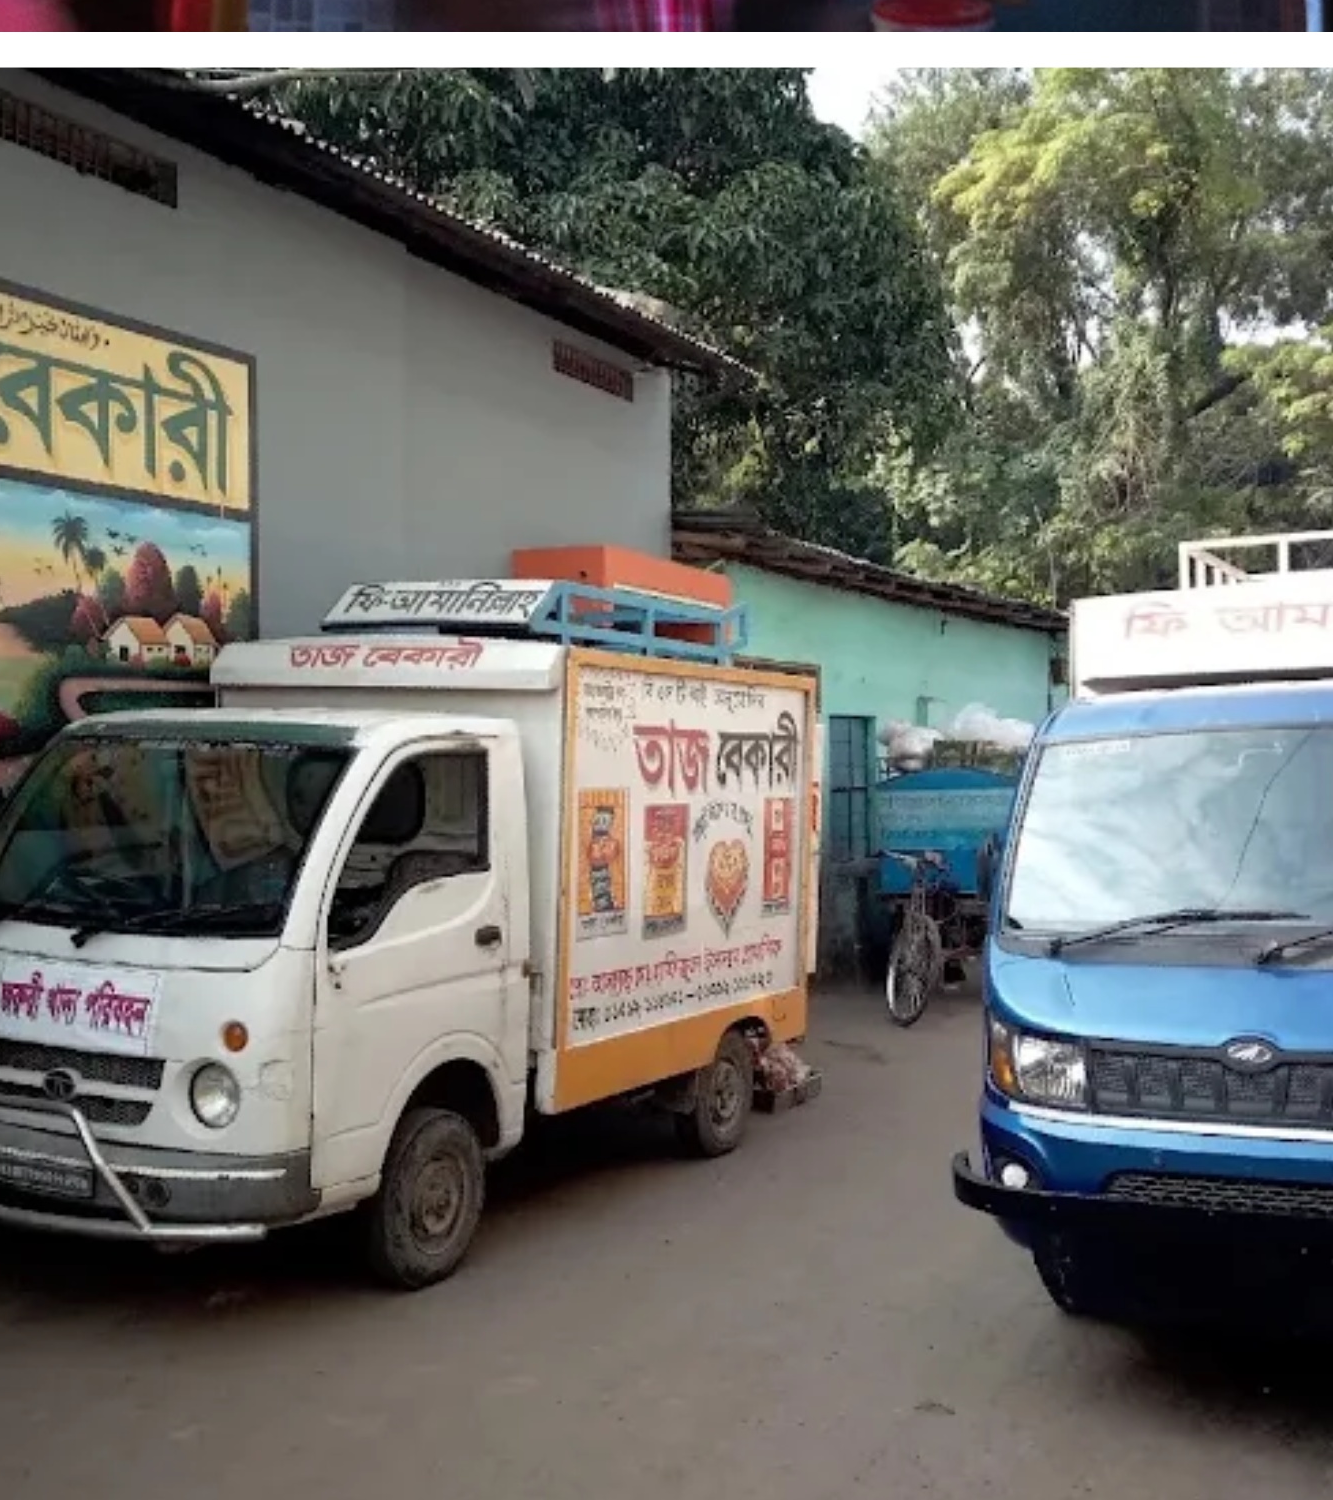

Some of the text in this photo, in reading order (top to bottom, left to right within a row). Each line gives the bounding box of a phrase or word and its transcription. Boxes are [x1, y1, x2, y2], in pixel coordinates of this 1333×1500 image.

[290, 636, 484, 670] তাজ বেকারী
[633, 711, 799, 799] তাজ বেকারী
